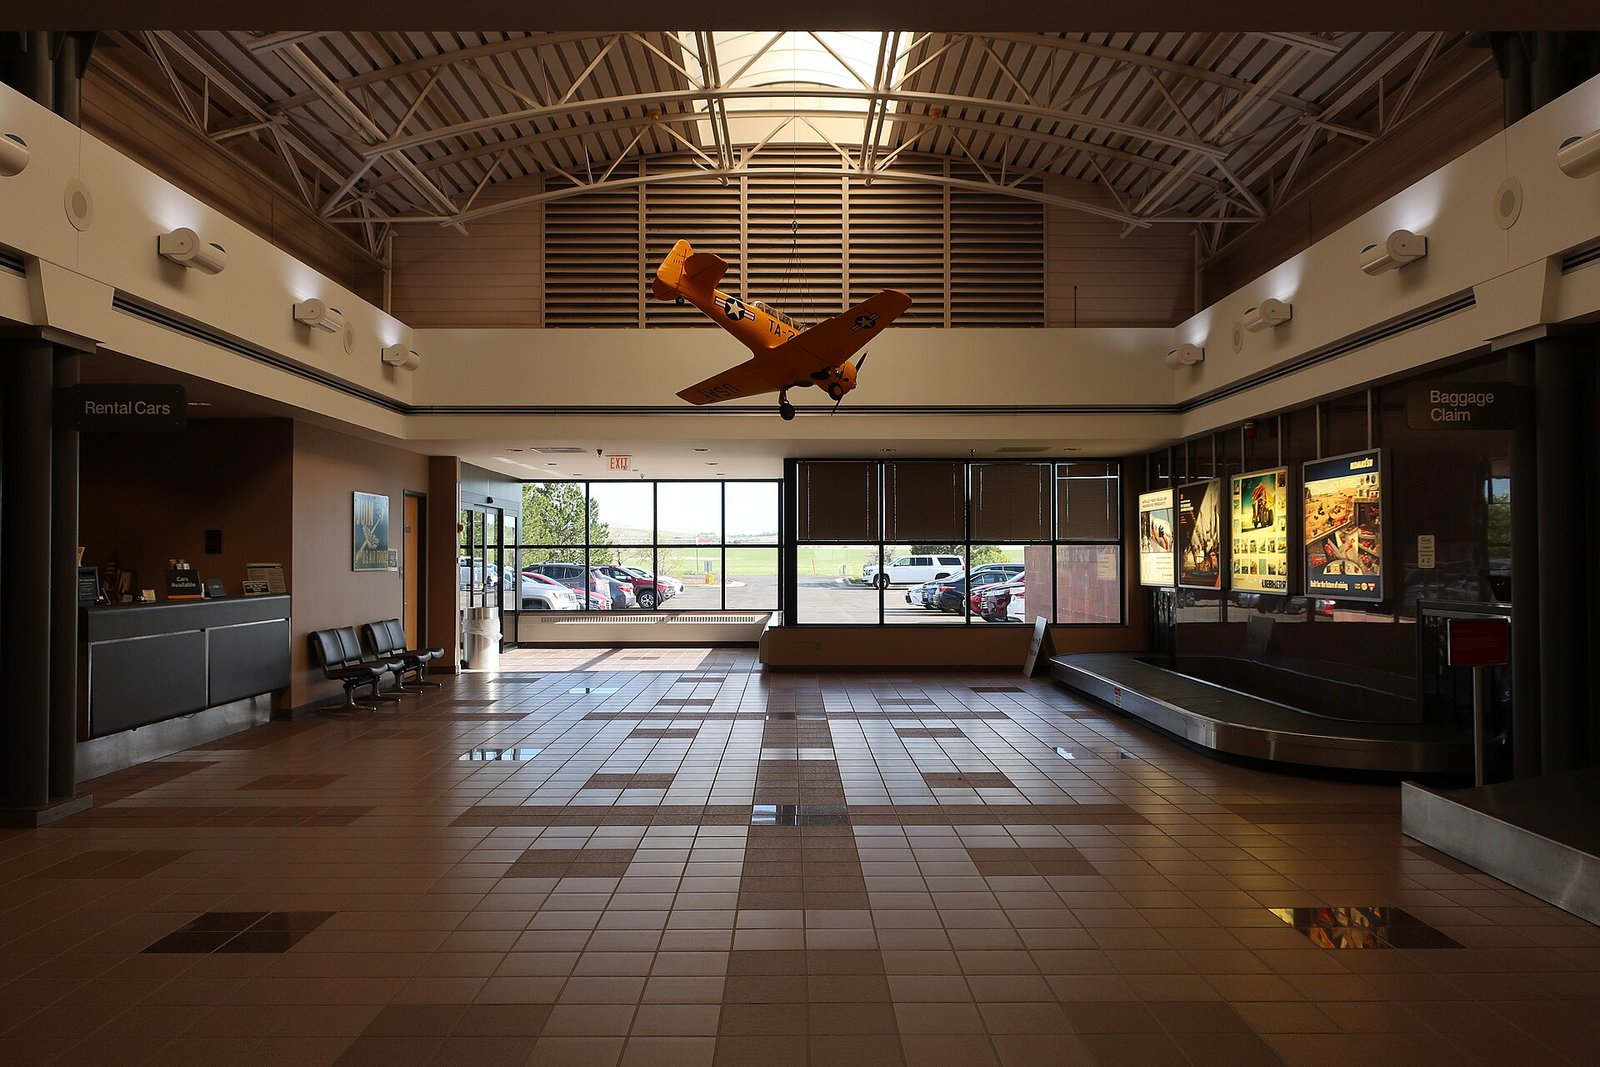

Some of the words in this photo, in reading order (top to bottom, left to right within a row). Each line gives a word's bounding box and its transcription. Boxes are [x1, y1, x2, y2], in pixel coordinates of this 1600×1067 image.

[1429, 390, 1495, 407] Baggage
[84, 401, 132, 415] Rental
[134, 401, 171, 415] Cars
[1430, 408, 1471, 422] Claim
[610, 457, 629, 470] EXIT
